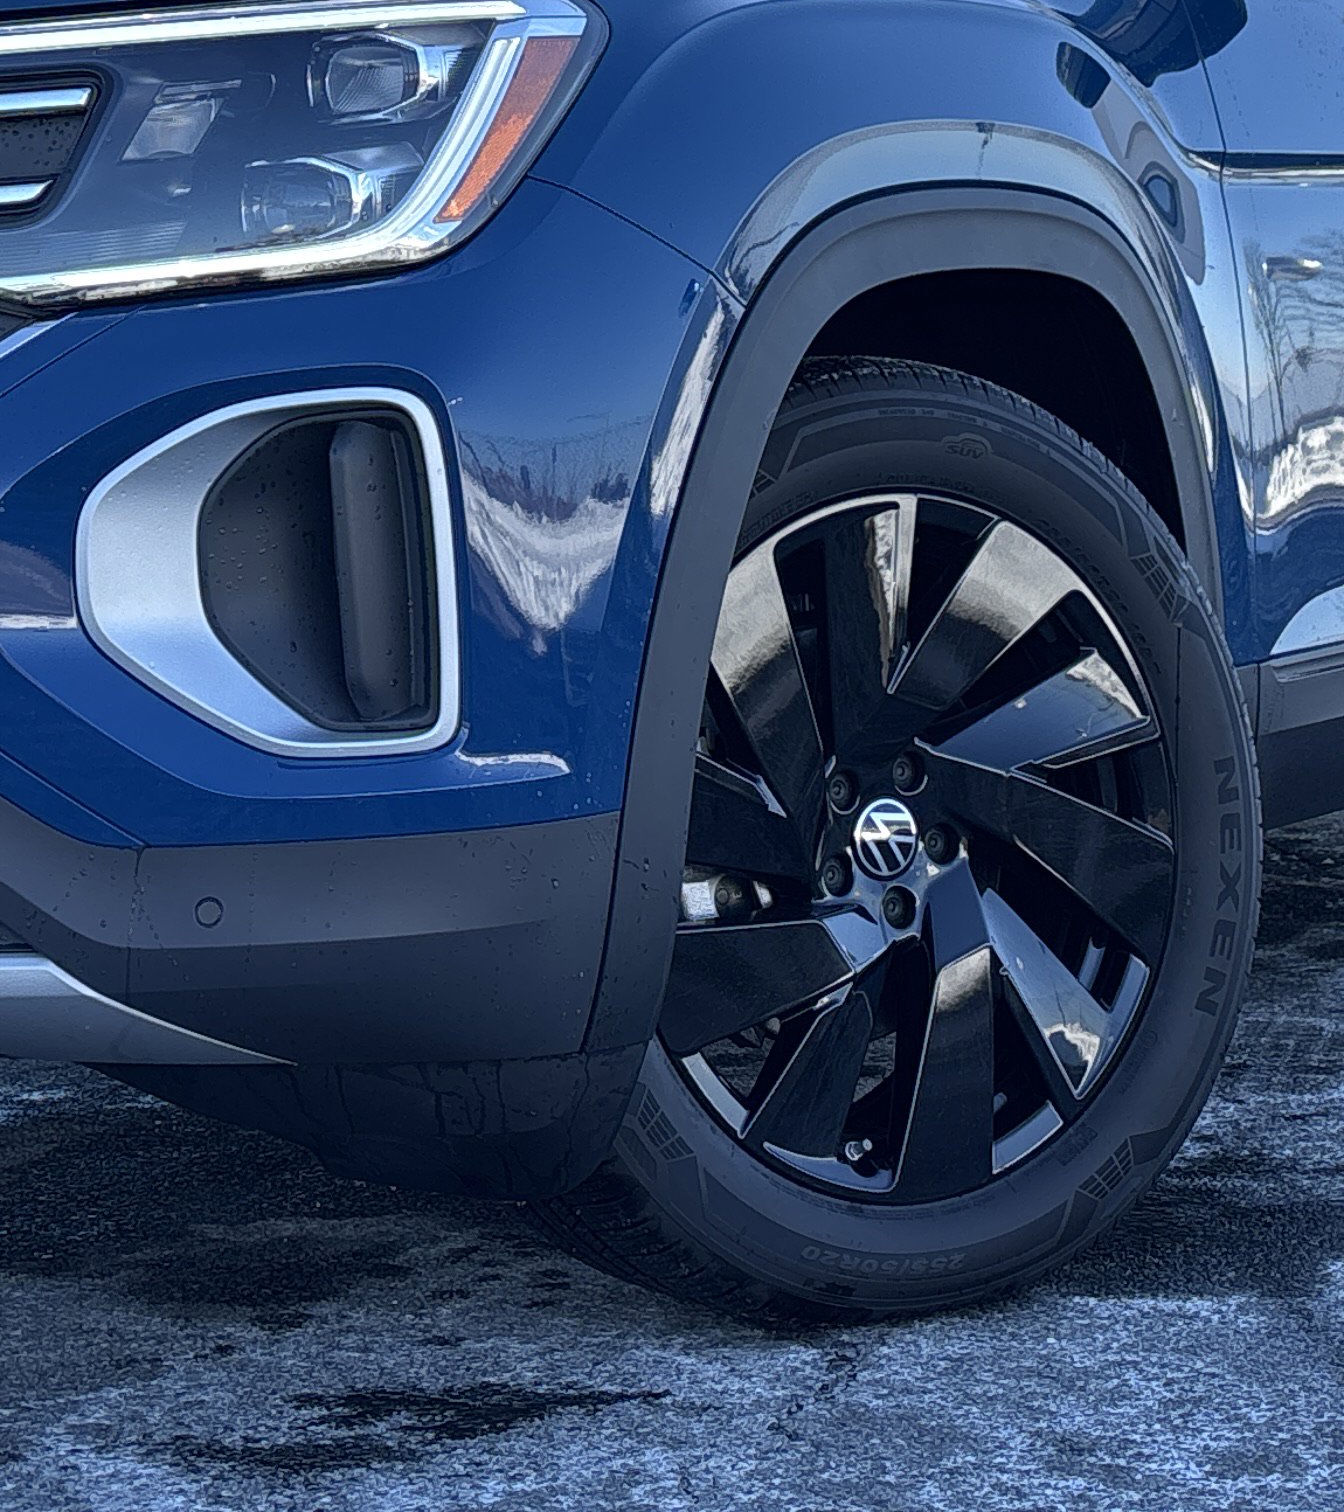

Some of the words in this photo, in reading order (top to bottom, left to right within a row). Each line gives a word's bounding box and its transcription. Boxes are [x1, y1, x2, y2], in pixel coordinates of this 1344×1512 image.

[944, 443, 985, 460] SUV
[1194, 755, 1242, 1018] NEXEN
[799, 1244, 967, 1276] 255/50R20
